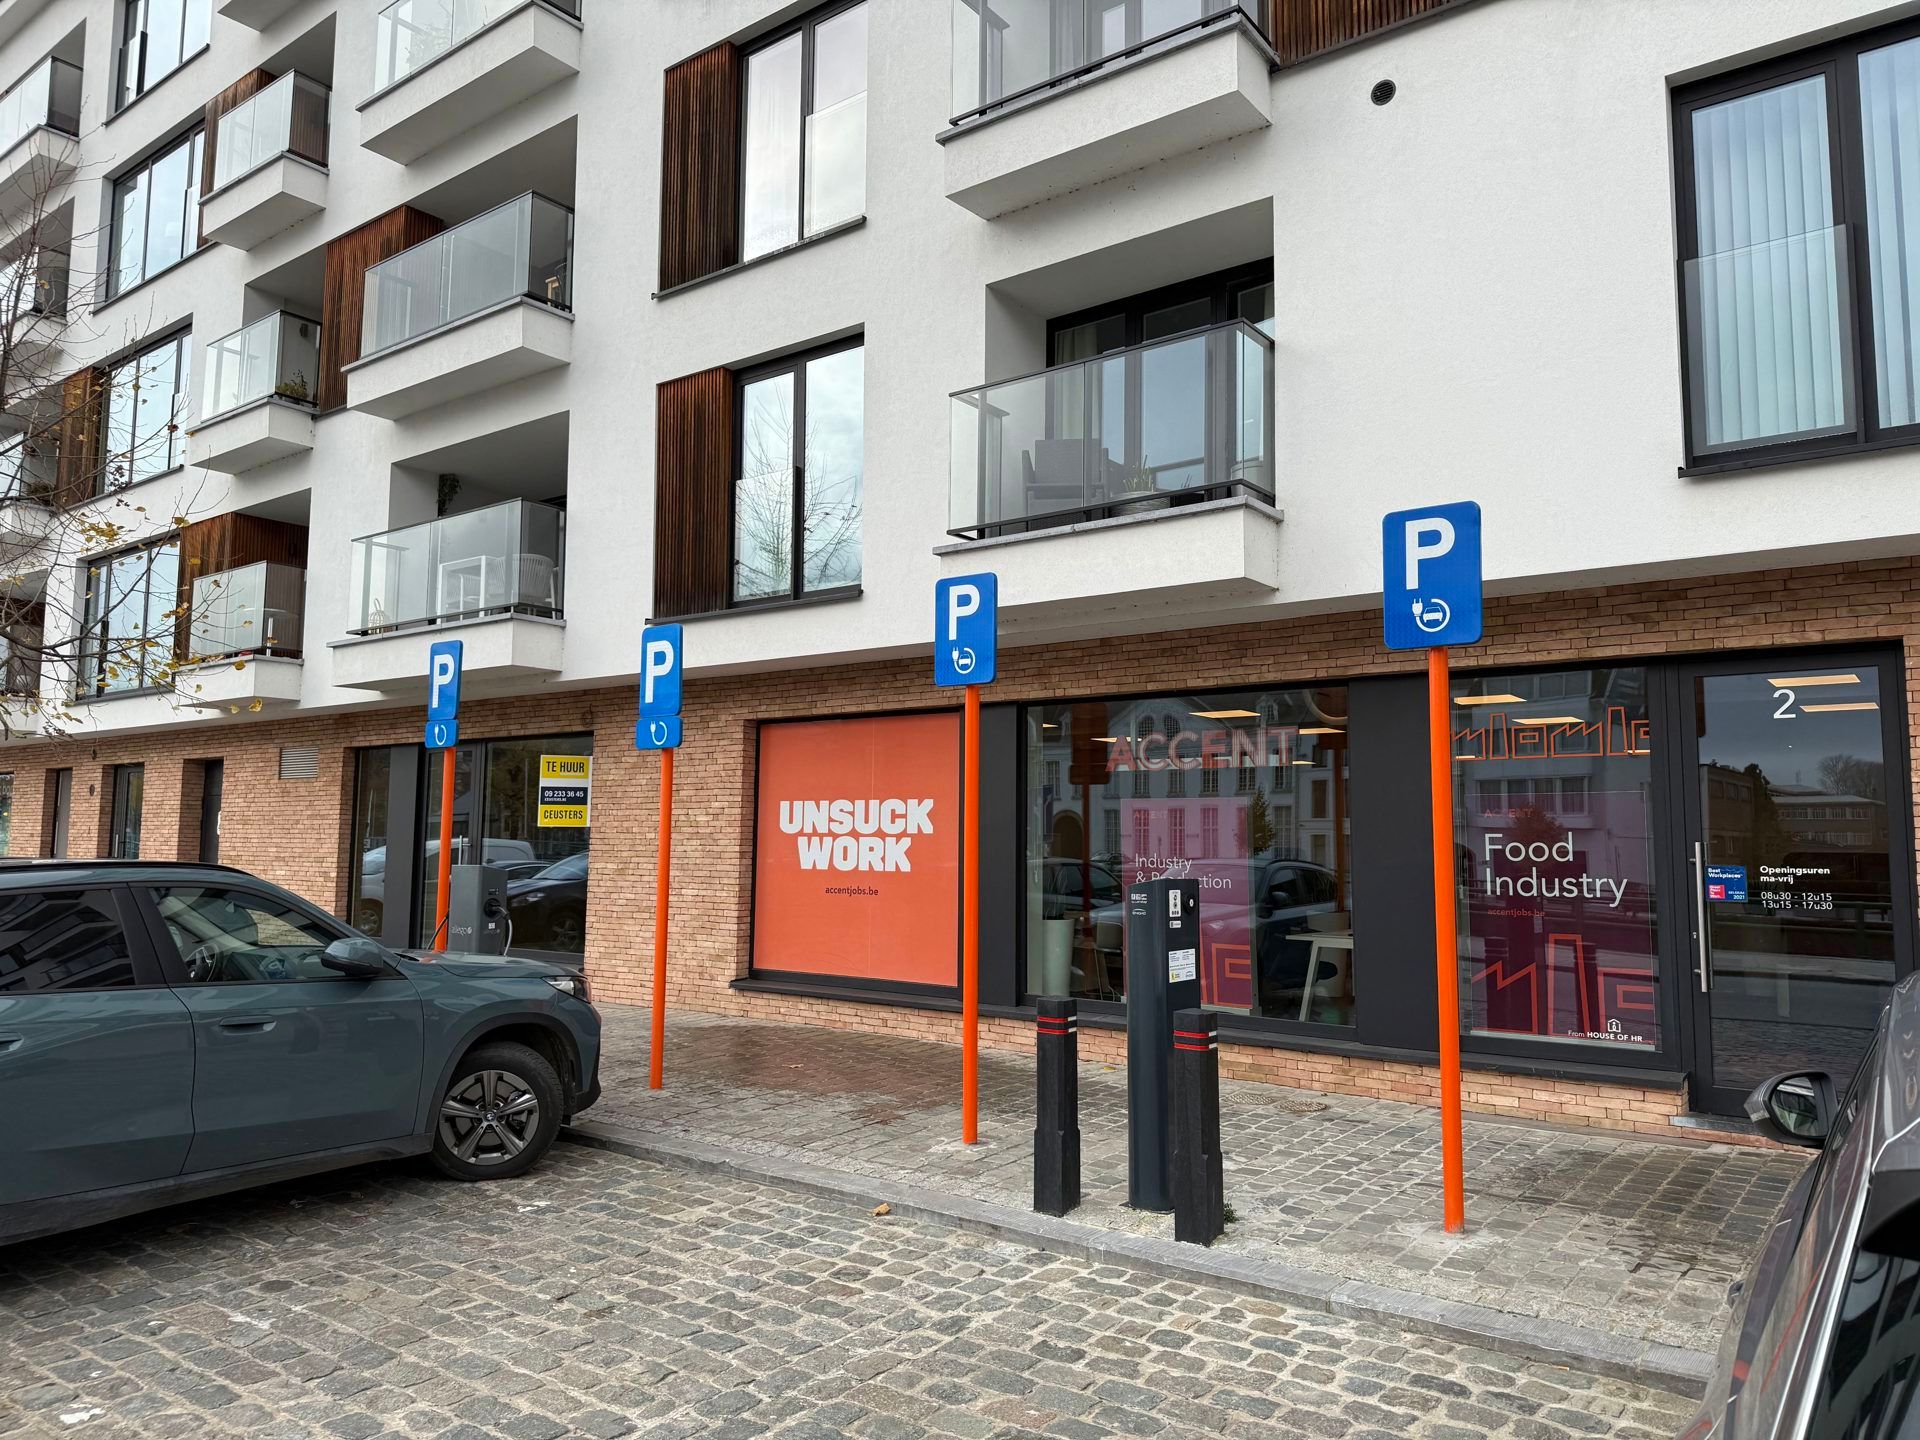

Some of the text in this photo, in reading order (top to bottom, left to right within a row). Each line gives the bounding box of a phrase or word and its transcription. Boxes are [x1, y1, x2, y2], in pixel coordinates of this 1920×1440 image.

[1405, 517, 1456, 590] P
[948, 584, 980, 640] P
[432, 654, 455, 708] P
[645, 640, 674, 703] P
[1772, 689, 1797, 719] 2
[1104, 725, 1299, 772] ACCENT
[546, 761, 585, 773] TE HUUR
[544, 810, 583, 819] CEUSTERS
[779, 798, 934, 834] UNSUCK
[797, 836, 912, 872] WORK
[1485, 831, 1574, 862] Food
[1135, 853, 1192, 873] Industry
[1760, 865, 1831, 876] Openingsuren
[1136, 870, 1232, 888] & Ption
[1486, 867, 1628, 908] Industry
[1760, 874, 1794, 884] ma-vrij
[825, 886, 879, 896] accentjobs.be
[1761, 891, 1791, 900] 08u30
[1801, 892, 1832, 901] 12u15
[1487, 908, 1546, 918] accentjobs.be
[1762, 901, 1792, 909] 13u15
[1802, 901, 1833, 910] 17u30
[1587, 1031, 1615, 1040] HOUSE
